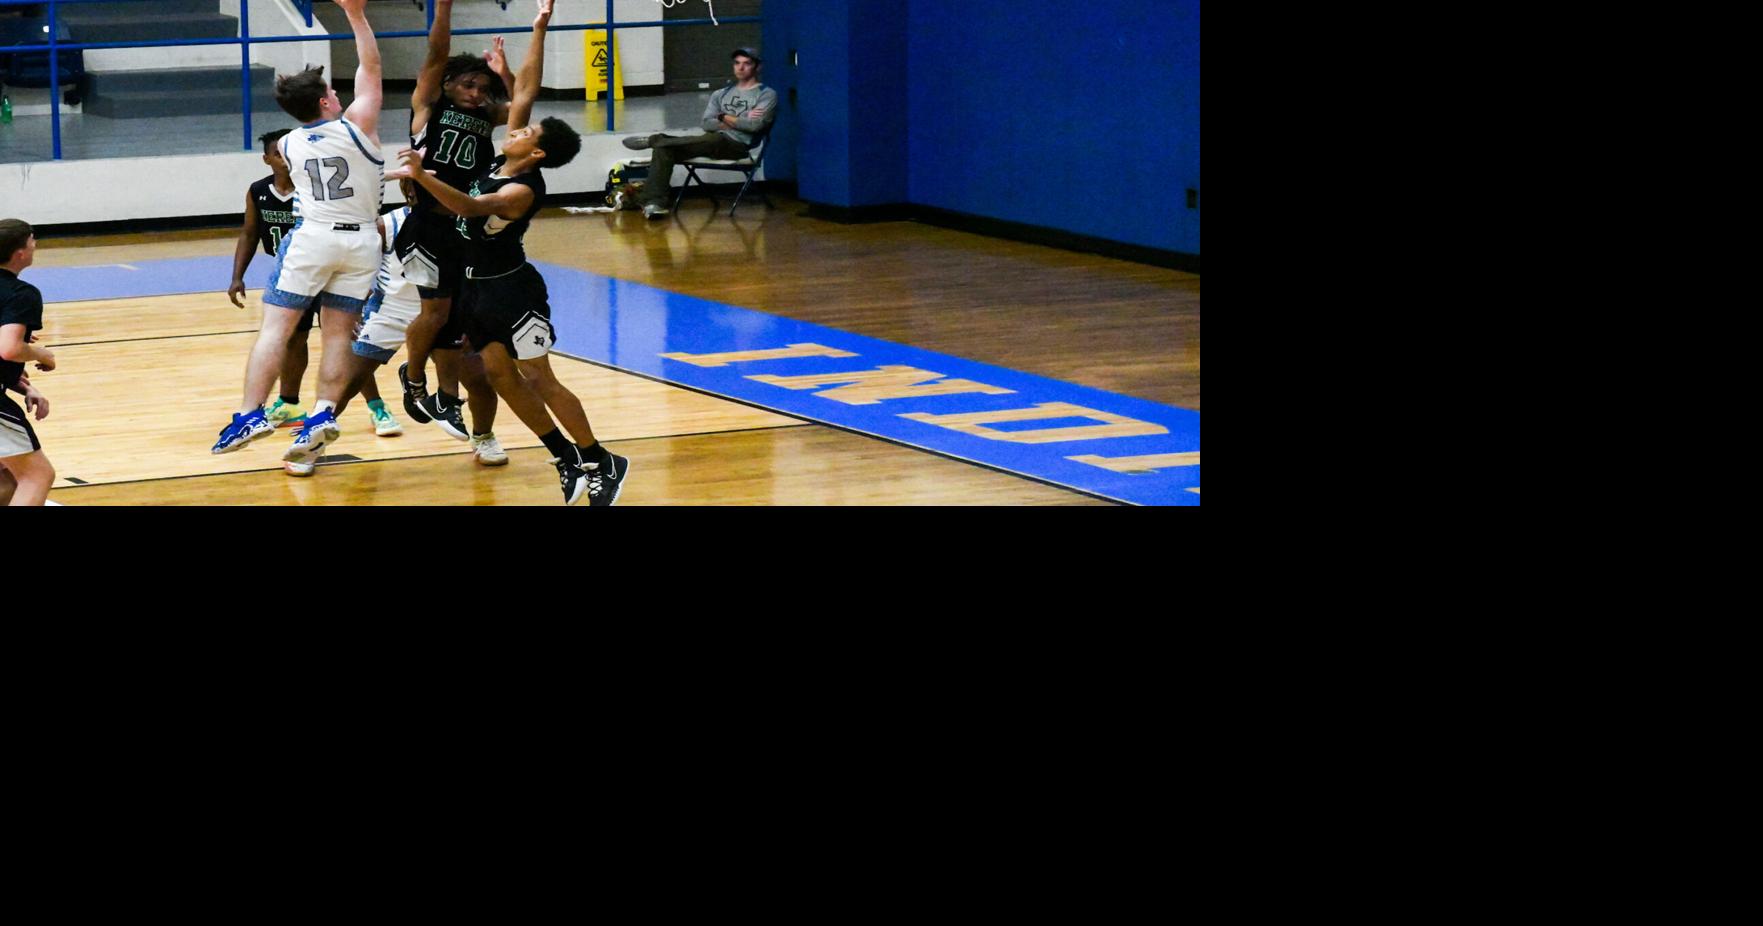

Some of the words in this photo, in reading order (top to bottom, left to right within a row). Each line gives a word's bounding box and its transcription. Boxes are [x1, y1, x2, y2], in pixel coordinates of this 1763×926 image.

[433, 129, 477, 169] 10
[304, 156, 354, 201] 12
[269, 226, 281, 254] 1
[657, 342, 1200, 494] INDI
